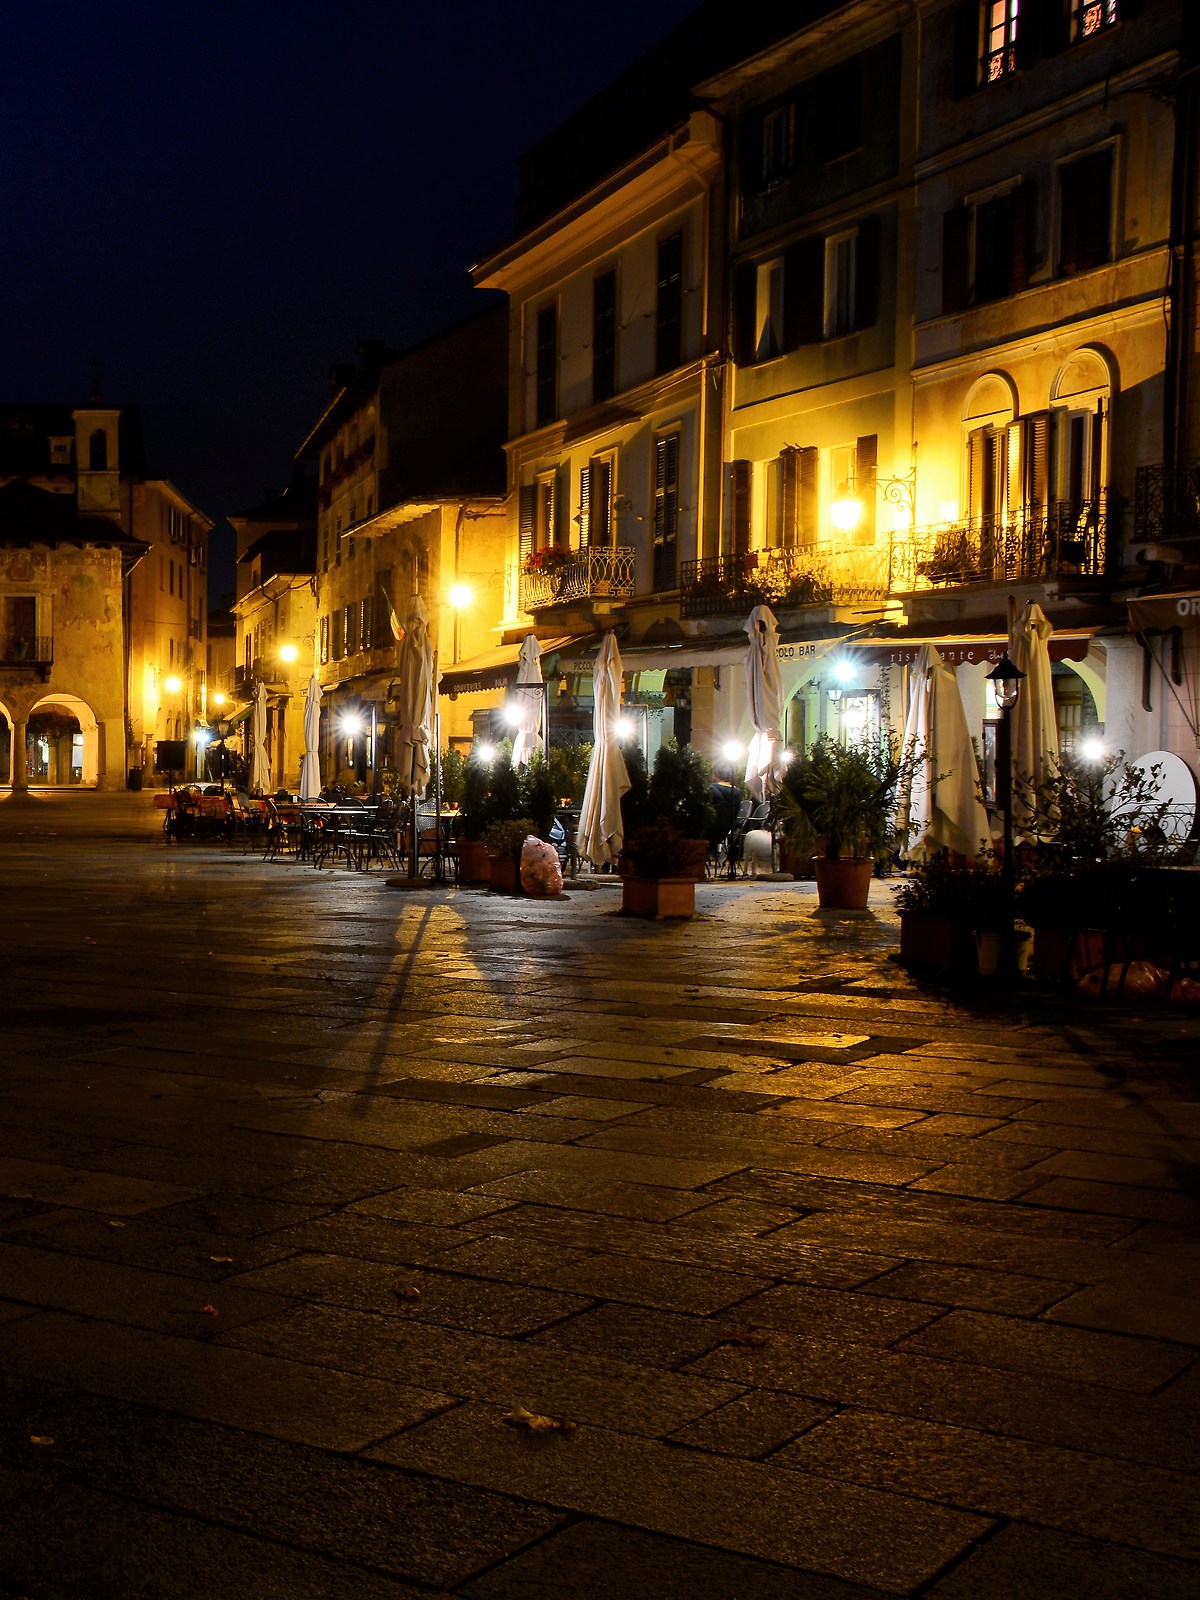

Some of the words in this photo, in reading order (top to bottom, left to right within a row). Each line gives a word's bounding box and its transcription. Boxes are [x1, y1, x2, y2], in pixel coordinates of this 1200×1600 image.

[799, 645, 816, 656] BAR
[890, 650, 974, 662] ristante
[573, 661, 594, 671] PICCOL
